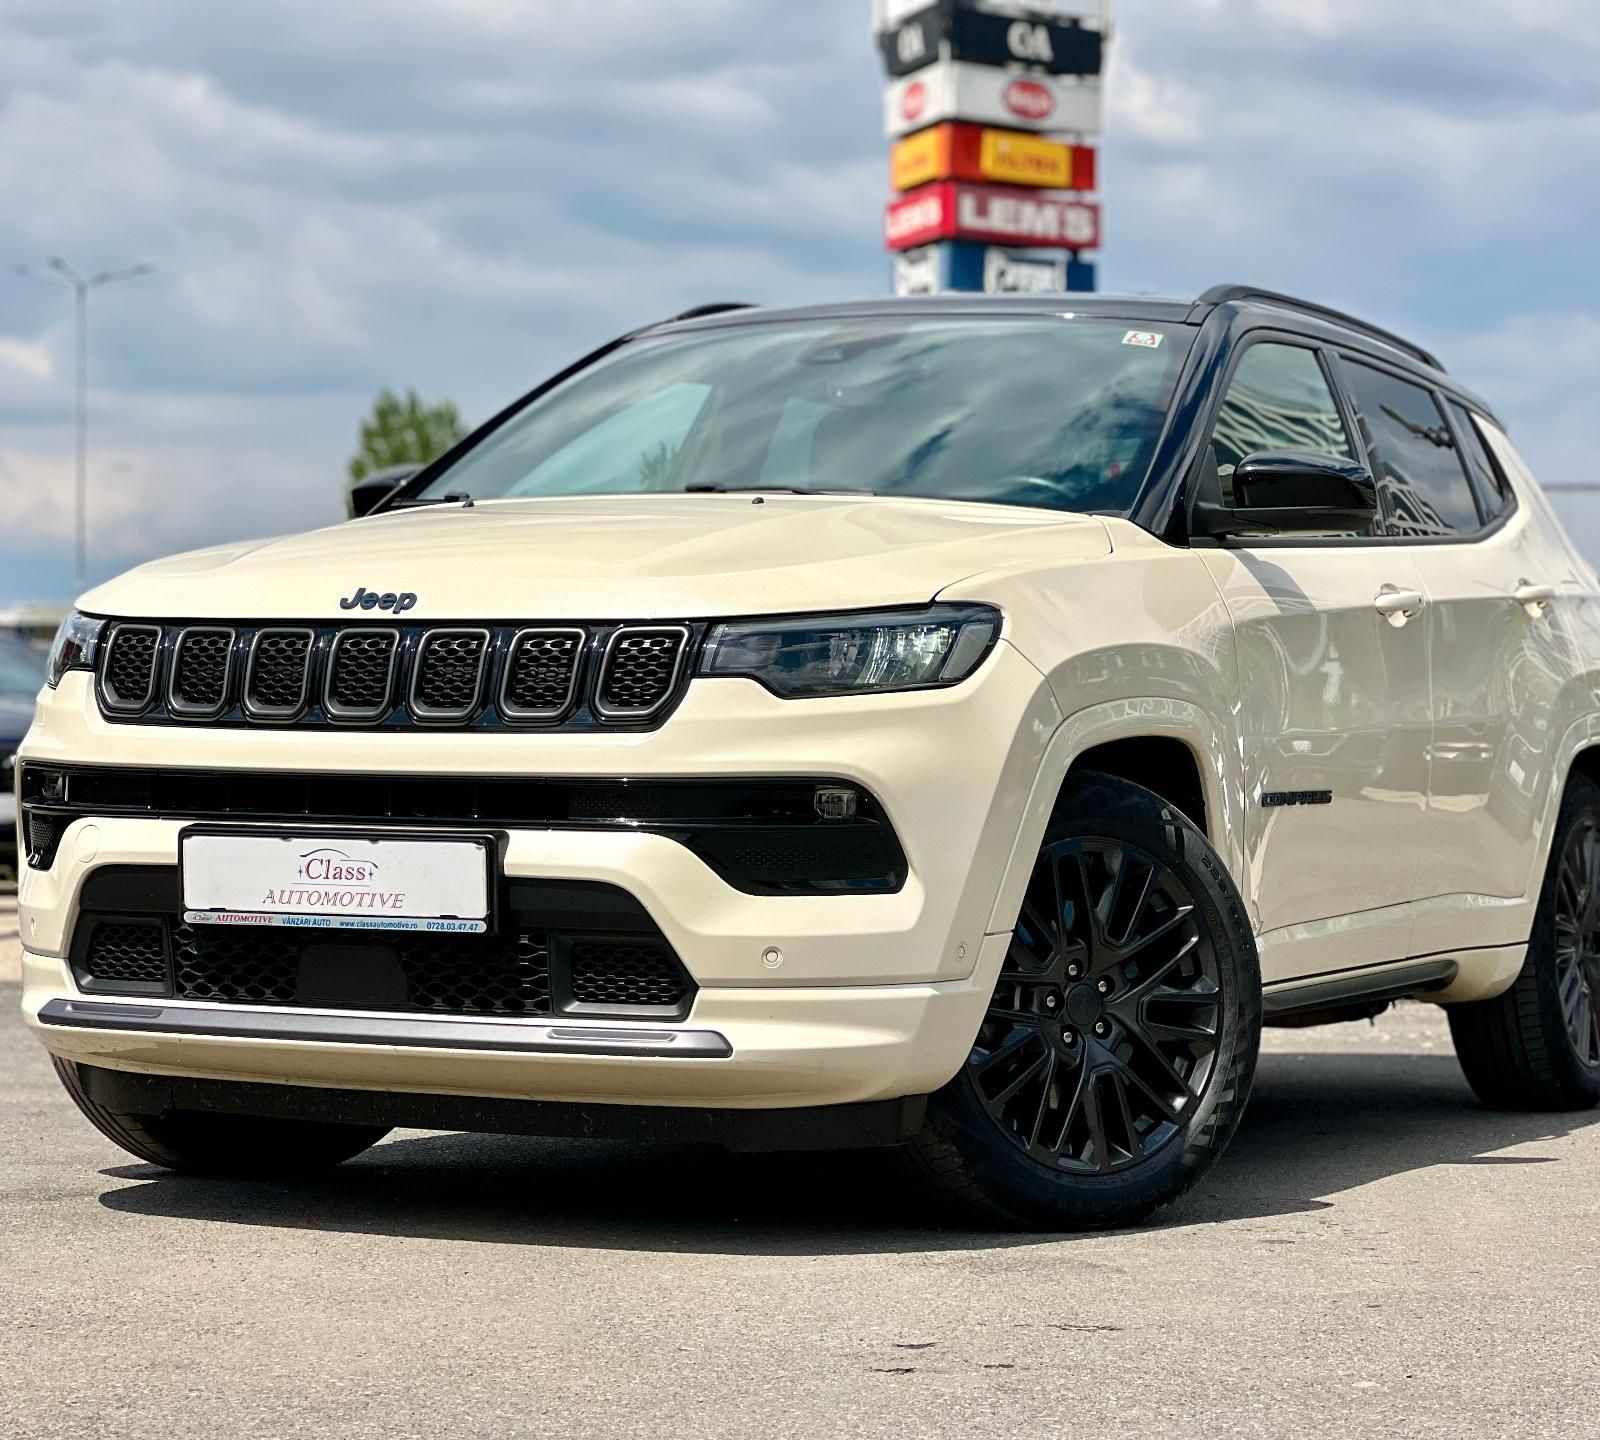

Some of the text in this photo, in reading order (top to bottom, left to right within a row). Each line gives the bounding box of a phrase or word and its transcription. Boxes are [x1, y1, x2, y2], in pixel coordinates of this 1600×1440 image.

[339, 587, 418, 615] Jeep
[305, 858, 366, 881] Class
[262, 889, 405, 909] AUTOMOTIVE
[215, 914, 273, 924] AUTOMOTIVE
[312, 918, 331, 927] AUTO
[339, 920, 417, 929] www.classautomotive.ro
[426, 922, 478, 931] 0728.03.47.47
